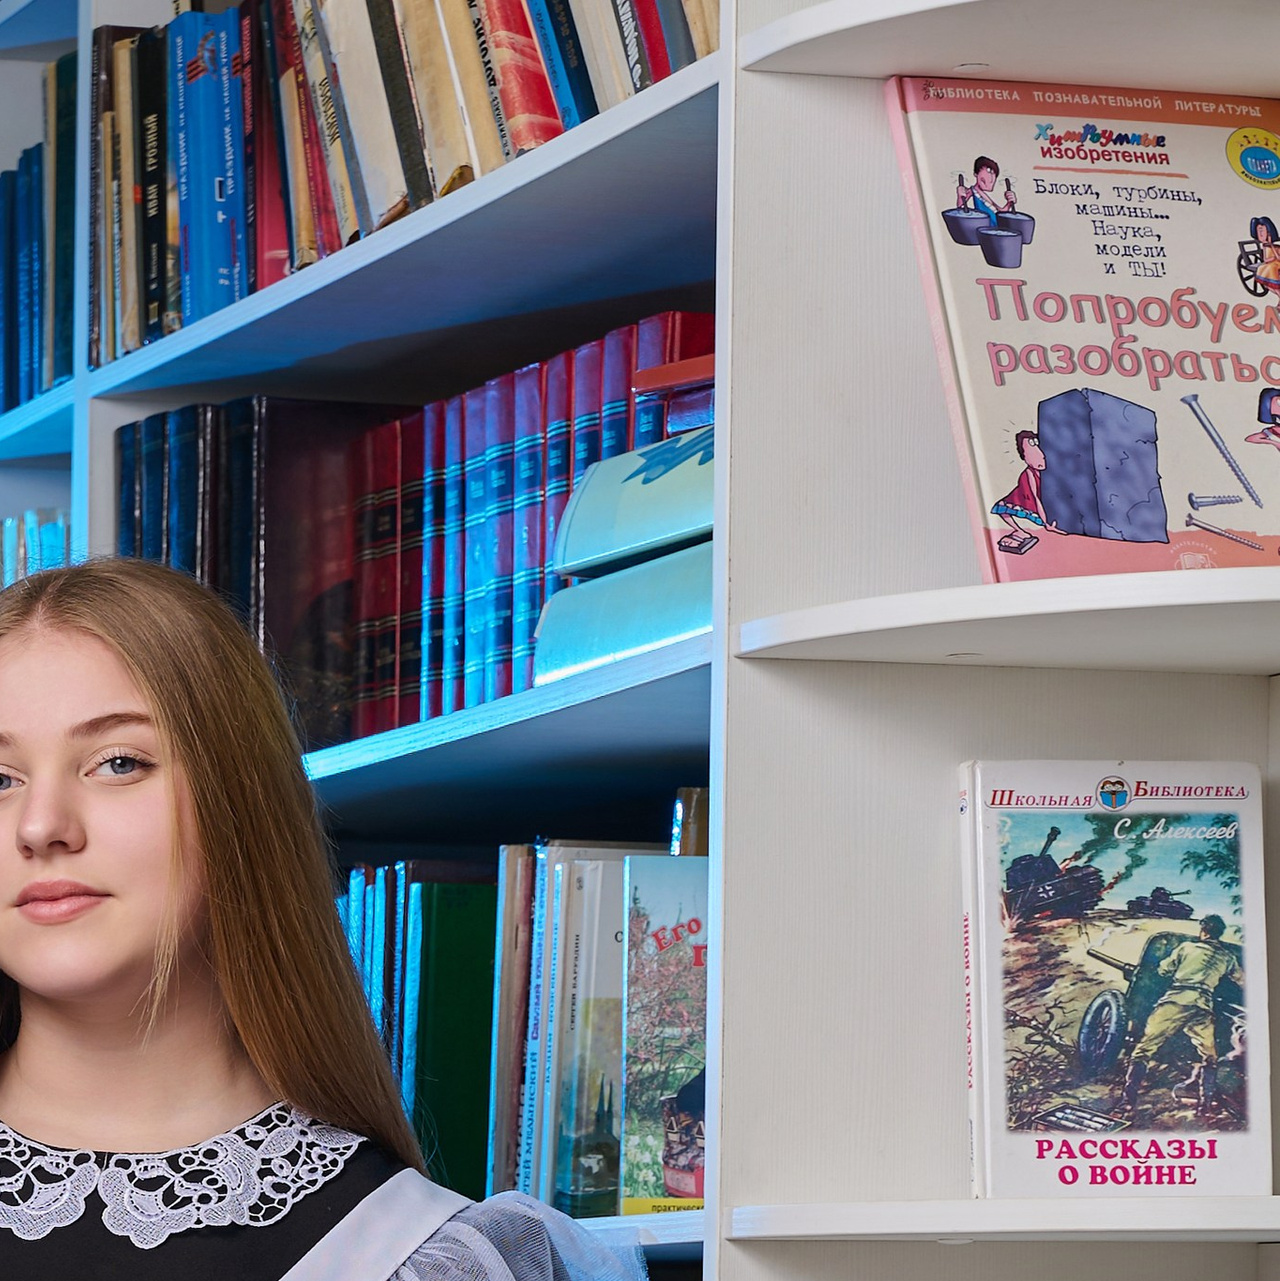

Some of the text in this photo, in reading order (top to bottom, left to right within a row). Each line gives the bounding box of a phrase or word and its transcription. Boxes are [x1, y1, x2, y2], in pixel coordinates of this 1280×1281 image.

[174, 35, 185, 71] УЛИЦЕ
[176, 73, 186, 110] НАШЕЙ
[929, 86, 1021, 101] БИБЛИОТЕКА
[1033, 90, 1163, 109] ПОЗНАВАТЕЛЬНОЙ
[1174, 100, 1262, 117] ЛИТЕРАТУРЫ
[178, 112, 186, 127] НА
[218, 30, 236, 195] ПРАЗДНИК НА НАШЕЙ УЛИЦЕ
[144, 113, 159, 172] ГРОЗНЫЙ
[1040, 144, 1170, 165] изобретения
[178, 131, 189, 201] ПРАЗДНИК
[145, 184, 159, 218] ИВАН
[1033, 178, 1203, 205] Блоки, турбины,
[1075, 201, 1170, 221] машины...
[1091, 219, 1163, 242] Наука,
[1095, 243, 1167, 258] модели
[1104, 260, 1167, 279] и ТЫ!
[990, 780, 1247, 808] ШКОЛЬНАЯ БИБЛИОТЕКА
[1142, 817, 1238, 841] Алексеев
[651, 916, 703, 953] Его
[966, 993, 974, 1090] РАССКАЗЫ
[1035, 1140, 1218, 1160] РАССКАЗЫ
[1058, 1160, 1197, 1185] О ВОЙНЕ
